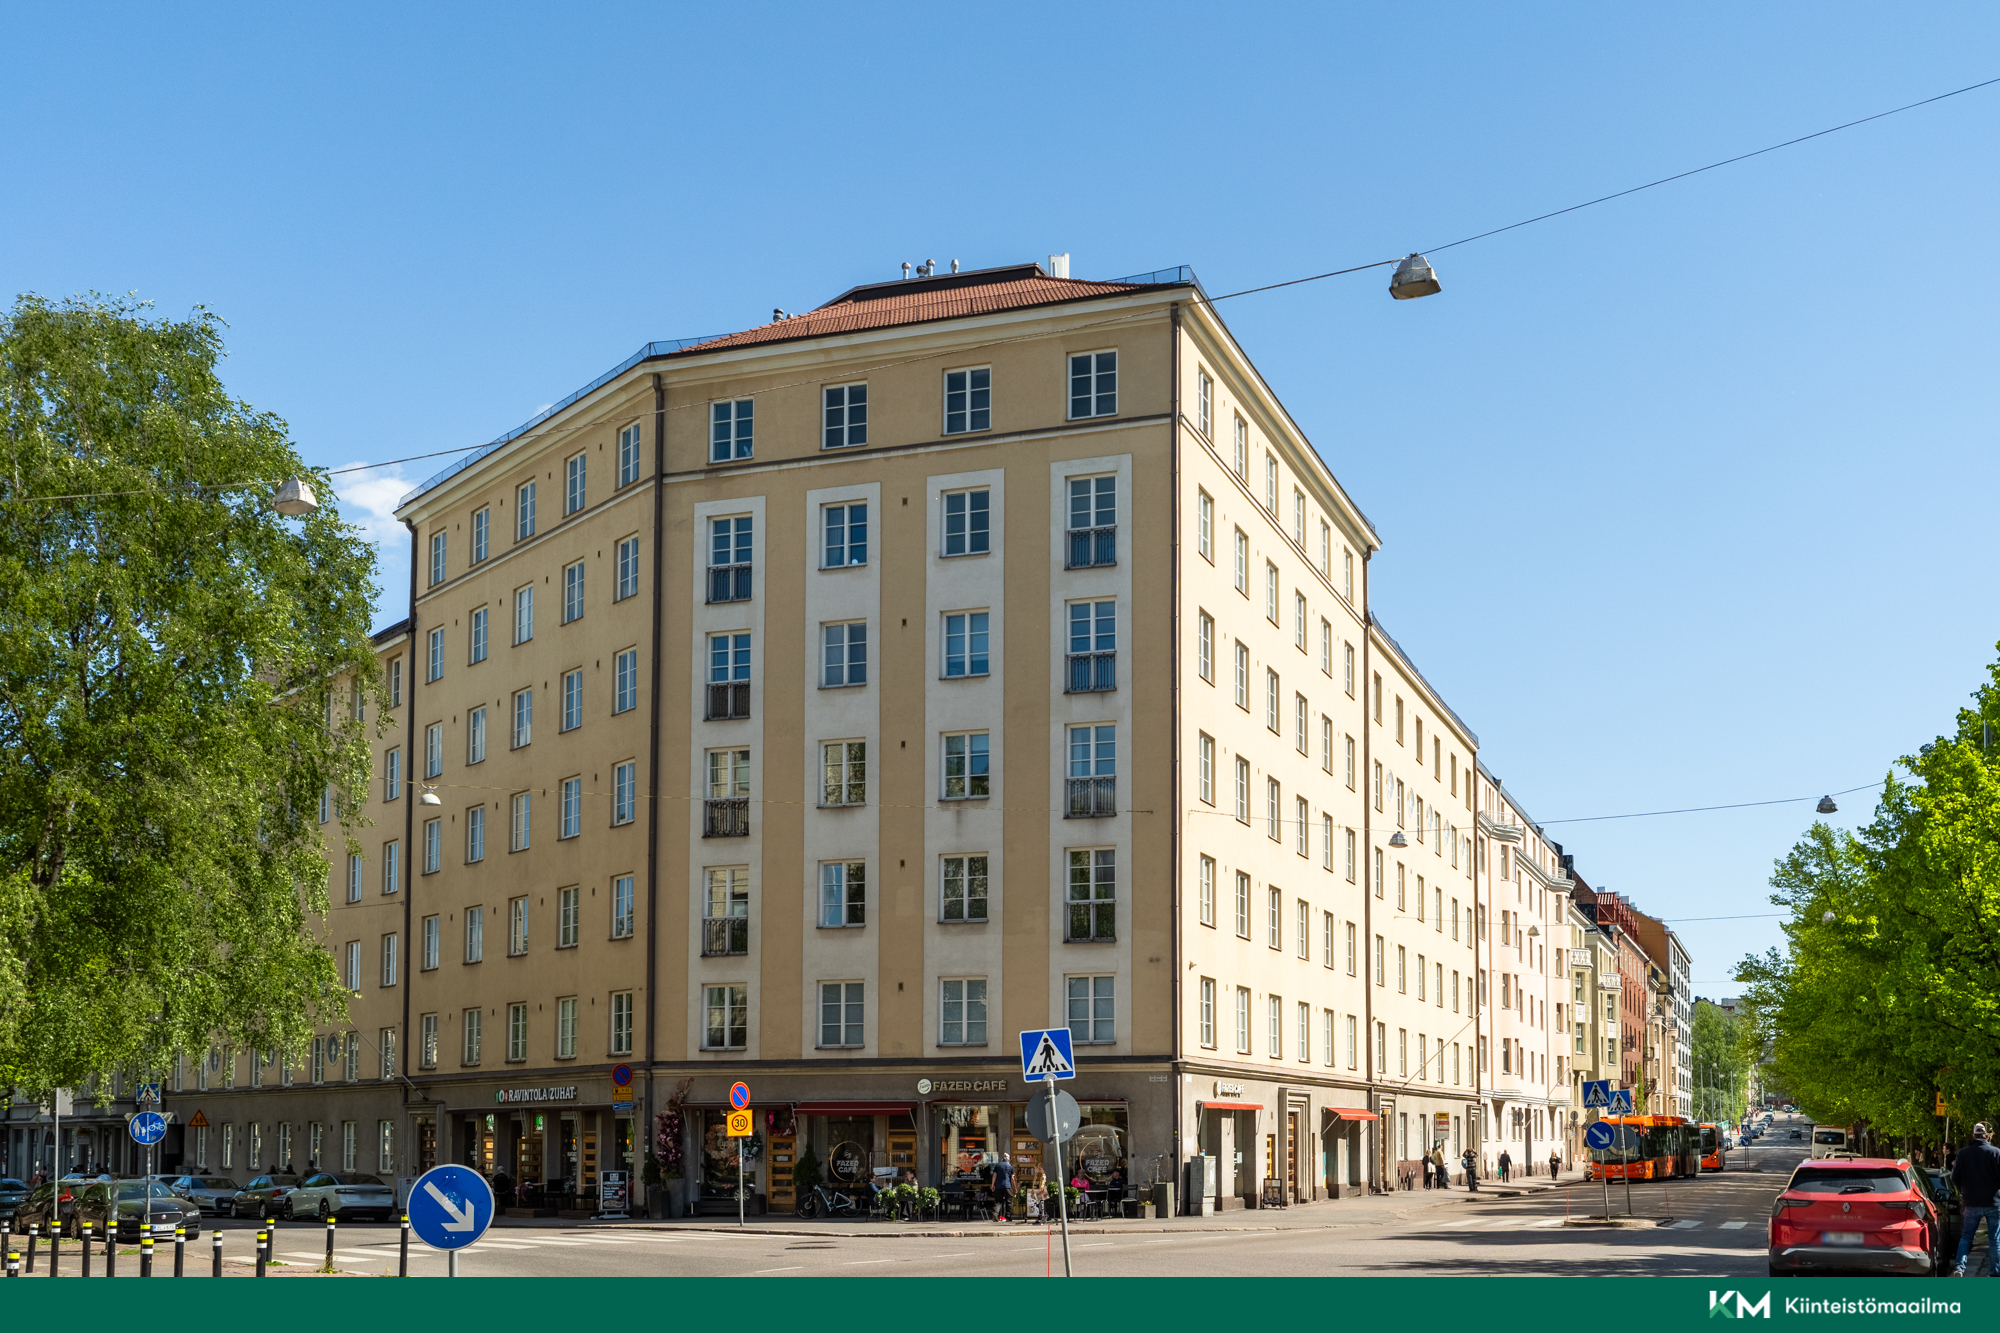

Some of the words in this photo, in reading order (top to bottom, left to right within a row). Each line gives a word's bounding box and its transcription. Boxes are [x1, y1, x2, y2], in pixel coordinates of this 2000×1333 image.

[932, 1081, 973, 1092] FAZER
[973, 1080, 1007, 1092] CAFÉ
[508, 1088, 548, 1102] RAVINTOLA
[549, 1086, 574, 1099] ZUHAT
[735, 1119, 745, 1127] 30
